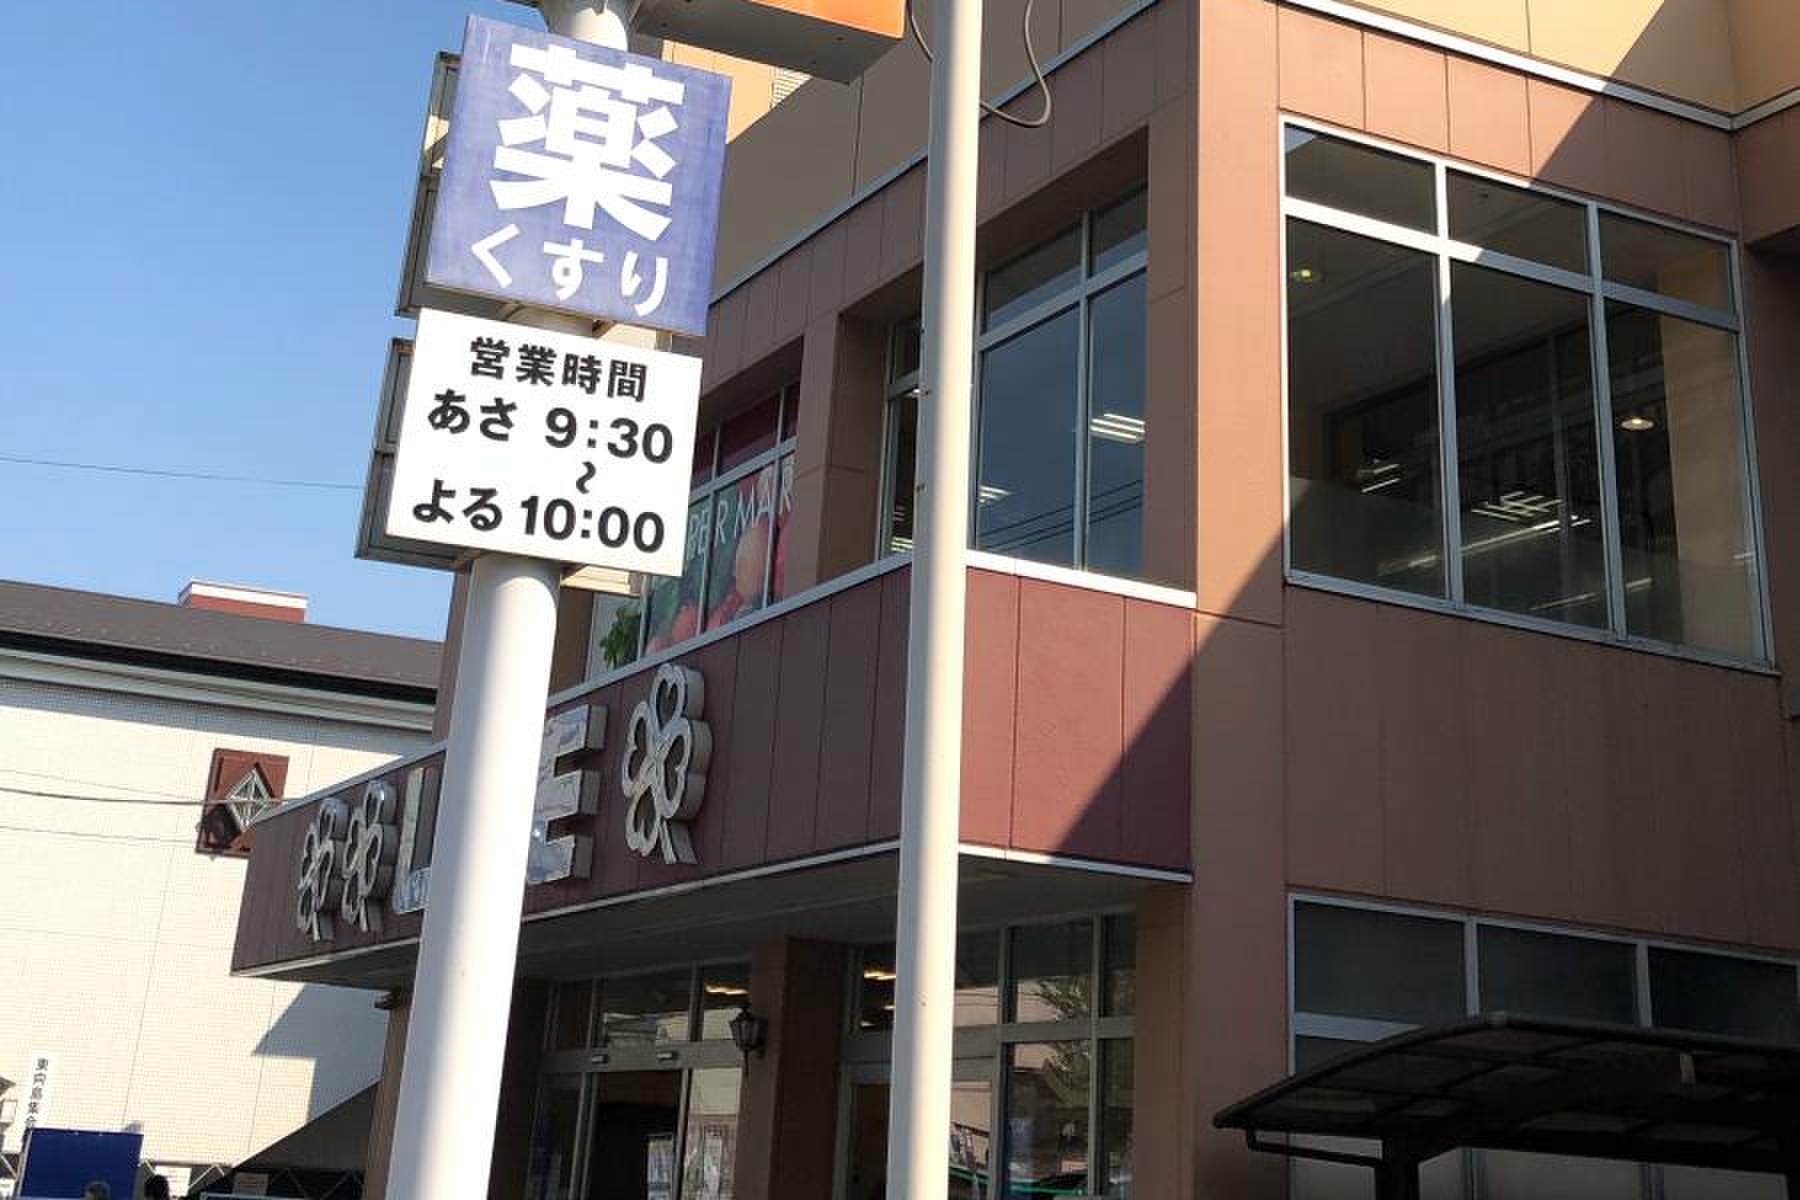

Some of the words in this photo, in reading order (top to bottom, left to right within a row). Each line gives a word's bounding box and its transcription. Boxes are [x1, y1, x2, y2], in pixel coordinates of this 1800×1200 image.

[489, 44, 685, 241] 薬
[471, 223, 669, 317] くすり
[469, 336, 647, 402] 営業時間
[427, 388, 518, 442] あさ
[544, 407, 673, 464] 9:30
[412, 478, 503, 532] よる
[520, 495, 665, 554] 10:00
